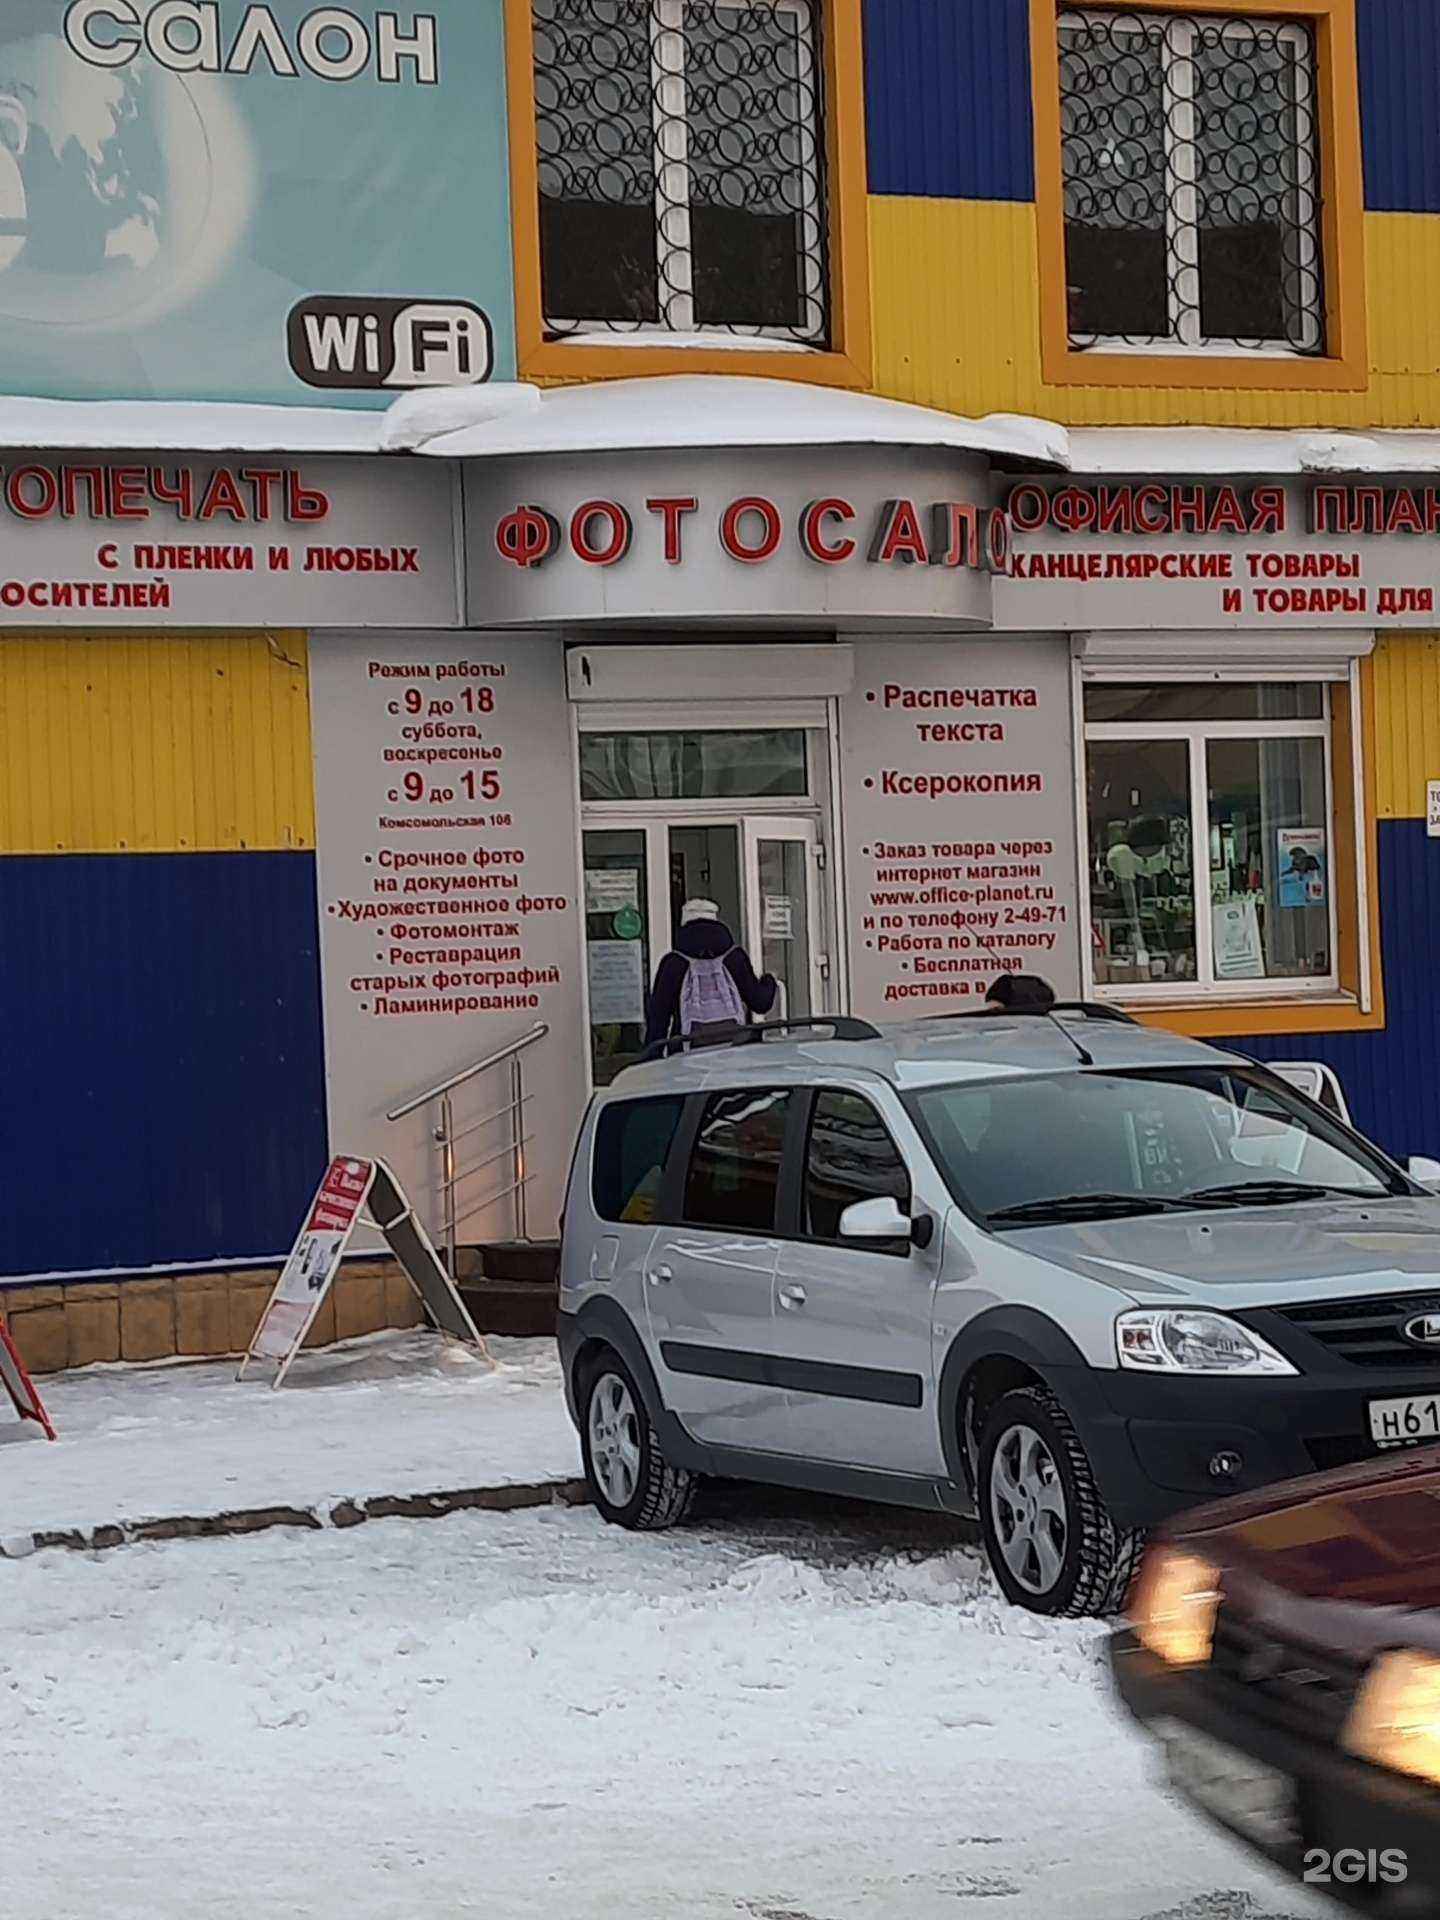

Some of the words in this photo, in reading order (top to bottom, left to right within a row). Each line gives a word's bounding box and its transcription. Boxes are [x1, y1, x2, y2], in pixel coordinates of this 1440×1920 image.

[64, 0, 438, 84] салон
[0, 464, 331, 522] ОПЕЧАТЬ
[1008, 482, 1287, 533] ОФИСНАЯ
[97, 543, 119, 570] С
[134, 544, 253, 570] ПЛЕНКИ
[268, 546, 289, 570] И
[304, 547, 420, 572] ЛЮБЫХ
[1009, 553, 1232, 582] КАНЦЕЛЯРСКИЕ
[1246, 553, 1360, 578] ТОВАРЫ
[0, 577, 170, 608] ОСИТЕЛЕЙ
[1223, 588, 1242, 612] И
[1253, 588, 1366, 613] ТОВАРЫ
[1377, 588, 1433, 615] ДЛЯ
[368, 662, 430, 678] Режим
[436, 660, 505, 681] работы
[387, 700, 399, 715] с
[404, 688, 422, 714] 9
[428, 700, 454, 717] до
[460, 686, 495, 713] 18
[884, 684, 1037, 708] Распечатка
[402, 722, 482, 742] суббота,
[916, 722, 1004, 742] текста
[383, 746, 502, 764] воскресенье
[387, 787, 399, 802] с
[404, 771, 424, 801] 9
[429, 787, 454, 803] до
[460, 769, 500, 800] 15
[881, 770, 1042, 799] Ксерокопия
[379, 815, 486, 829] Комсомольская
[378, 849, 467, 871] Срочное
[473, 847, 525, 869] фото
[874, 842, 926, 859] Заказ
[932, 843, 996, 860] товара
[1001, 841, 1053, 858] через
[374, 877, 397, 893] на
[403, 873, 518, 894] документы
[877, 867, 962, 884] интернет
[967, 864, 1041, 879] магазин
[870, 884, 1054, 906] www.office-planet.ru
[338, 898, 510, 922] Художественное
[515, 894, 567, 916] фото
[863, 915, 874, 930] и
[880, 914, 903, 929] по
[908, 910, 999, 930] телефону
[1004, 905, 1067, 925] 2-49-71
[390, 921, 520, 940] Фотомонтаж
[877, 935, 943, 951] Работа
[948, 935, 970, 949] по
[976, 932, 1056, 950] каталогу
[390, 945, 521, 967] Реставрация
[914, 956, 1023, 973] Бесплатная
[350, 974, 427, 994] старых
[432, 965, 560, 988] фотографий
[885, 981, 970, 1001] доставка
[975, 981, 987, 994] в
[374, 993, 539, 1016] Ламинирование
